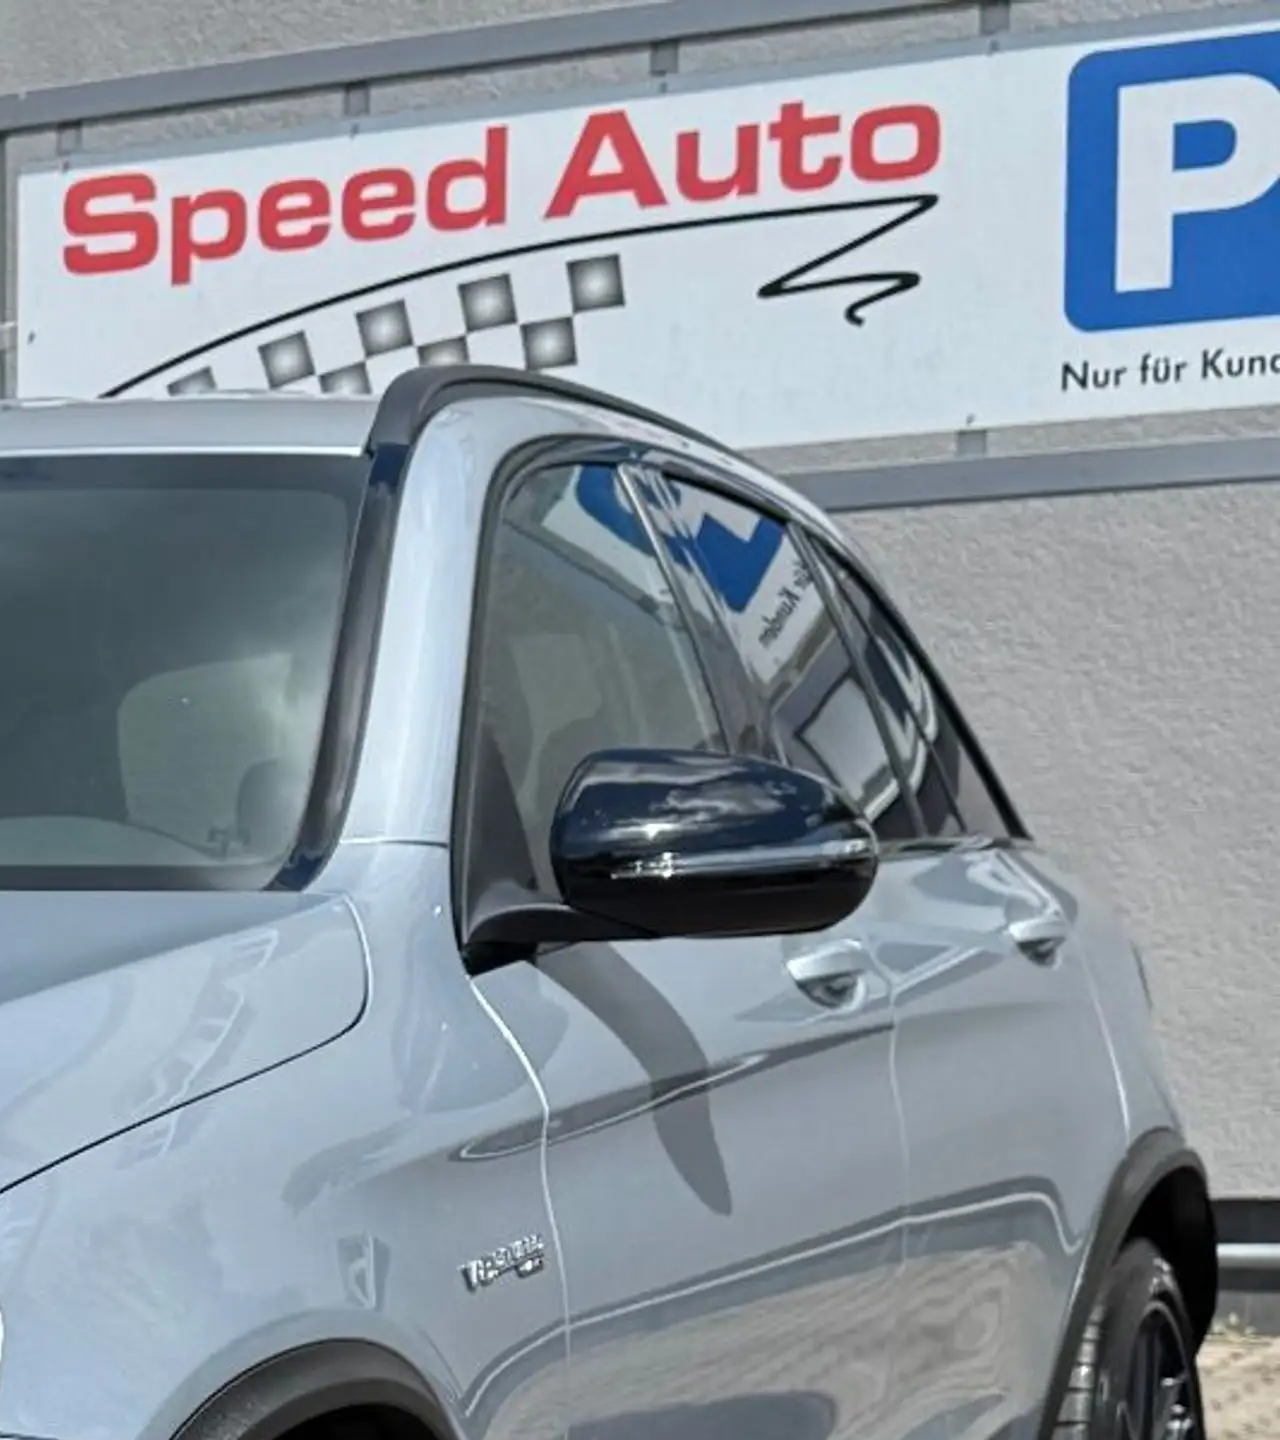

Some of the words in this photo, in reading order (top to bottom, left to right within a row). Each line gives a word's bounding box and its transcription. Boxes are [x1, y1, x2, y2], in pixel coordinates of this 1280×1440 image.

[63, 124, 508, 285] Speed
[543, 102, 940, 220] Auto
[1115, 73, 1280, 293] P
[1061, 361, 1127, 392] Nur
[1141, 352, 1188, 385] für
